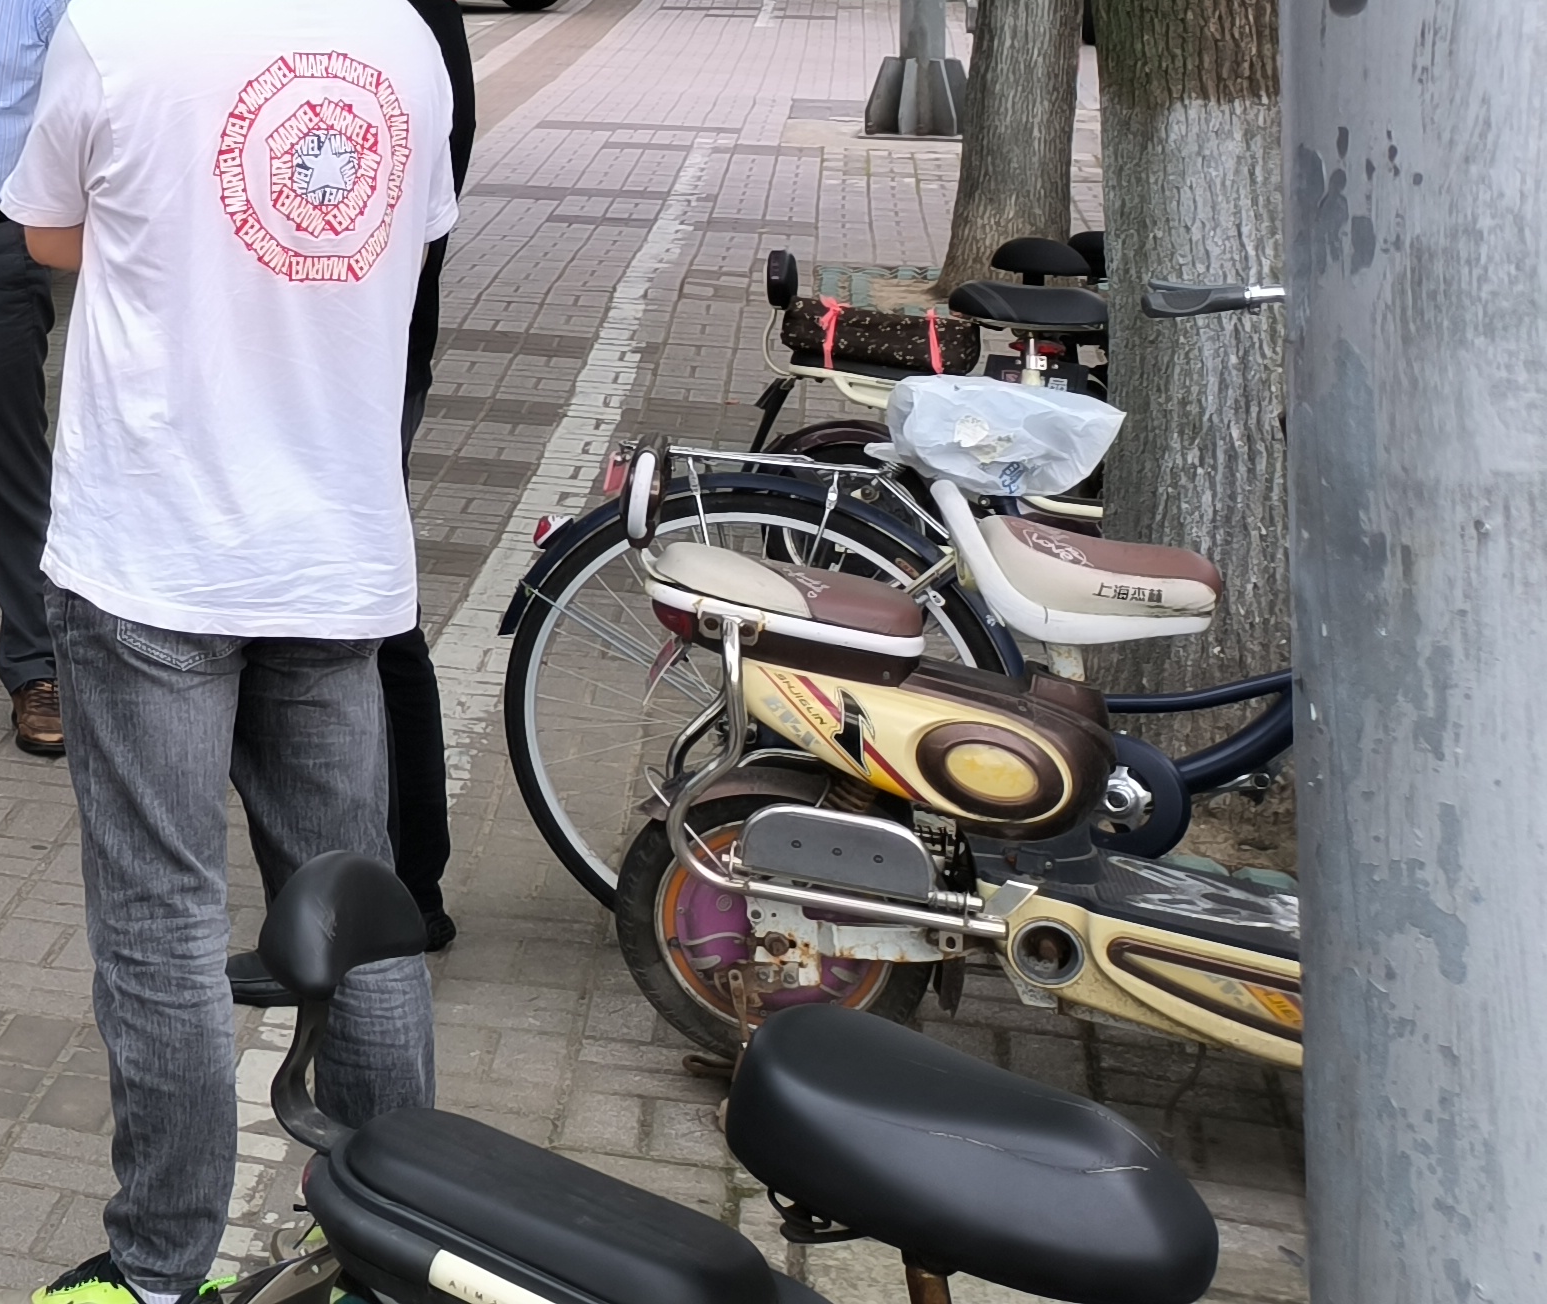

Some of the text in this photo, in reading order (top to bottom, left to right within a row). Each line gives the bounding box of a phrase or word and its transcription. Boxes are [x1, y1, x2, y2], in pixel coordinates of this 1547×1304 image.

[241, 59, 294, 111] MARVEL
[329, 52, 379, 93] MARVEL
[267, 104, 318, 157] MARVEL
[319, 99, 369, 145] MARVEL
[220, 152, 247, 213] MARVEL
[325, 177, 373, 235] MARVEL
[276, 188, 326, 237] MARVEL
[239, 218, 282, 273] MARVEL
[291, 256, 349, 281] MARVEL
[1092, 582, 1164, 604] 上海杰林
[448, 1280, 499, 1304] AIM
